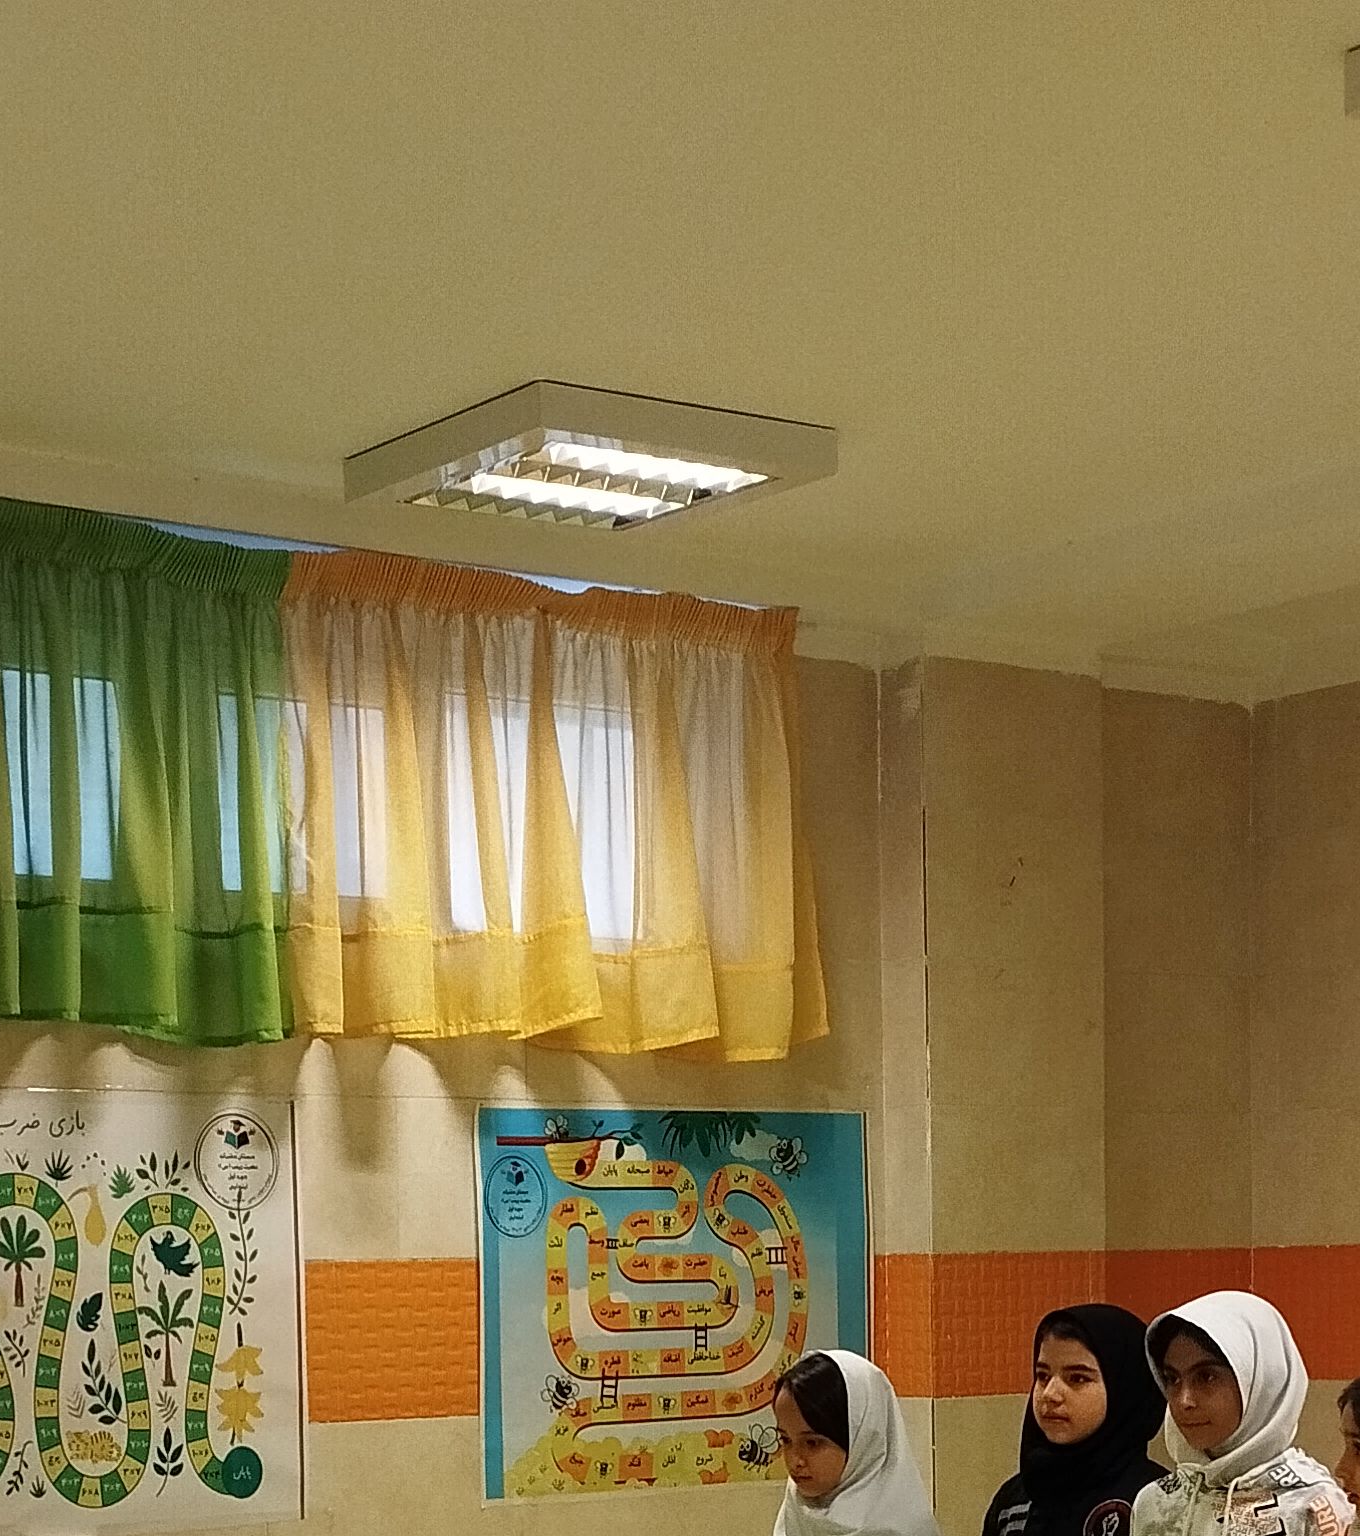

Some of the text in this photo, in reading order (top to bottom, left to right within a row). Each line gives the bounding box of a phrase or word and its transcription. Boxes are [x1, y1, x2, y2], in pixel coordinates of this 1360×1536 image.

[49, 1110, 86, 1138] بازی
[603, 1164, 618, 1177] پایان
[626, 1164, 650, 1175] صبحانه
[656, 1164, 674, 1177] حیاط
[733, 1170, 749, 1183] وطن
[559, 1203, 575, 1217] قطار
[584, 1206, 599, 1218] نظم
[630, 1215, 650, 1228] بعضی
[777, 1204, 793, 1230] صندوق
[731, 1225, 748, 1237] طناب
[588, 1235, 605, 1248] وسط
[631, 1257, 650, 1270] باعث
[590, 1271, 606, 1282] جمع
[600, 1307, 622, 1319] صورت
[659, 1304, 680, 1318] ریاضی
[686, 1303, 712, 1316] مواظبت
[552, 1334, 574, 1347] حوض
[727, 1342, 745, 1359] کثیف
[604, 1355, 621, 1369] قطره
[687, 1351, 721, 1365] خداحافظی
[627, 1397, 647, 1411] مظلوم
[686, 1394, 709, 1408] غمگین
[695, 1453, 714, 1467] شروع
